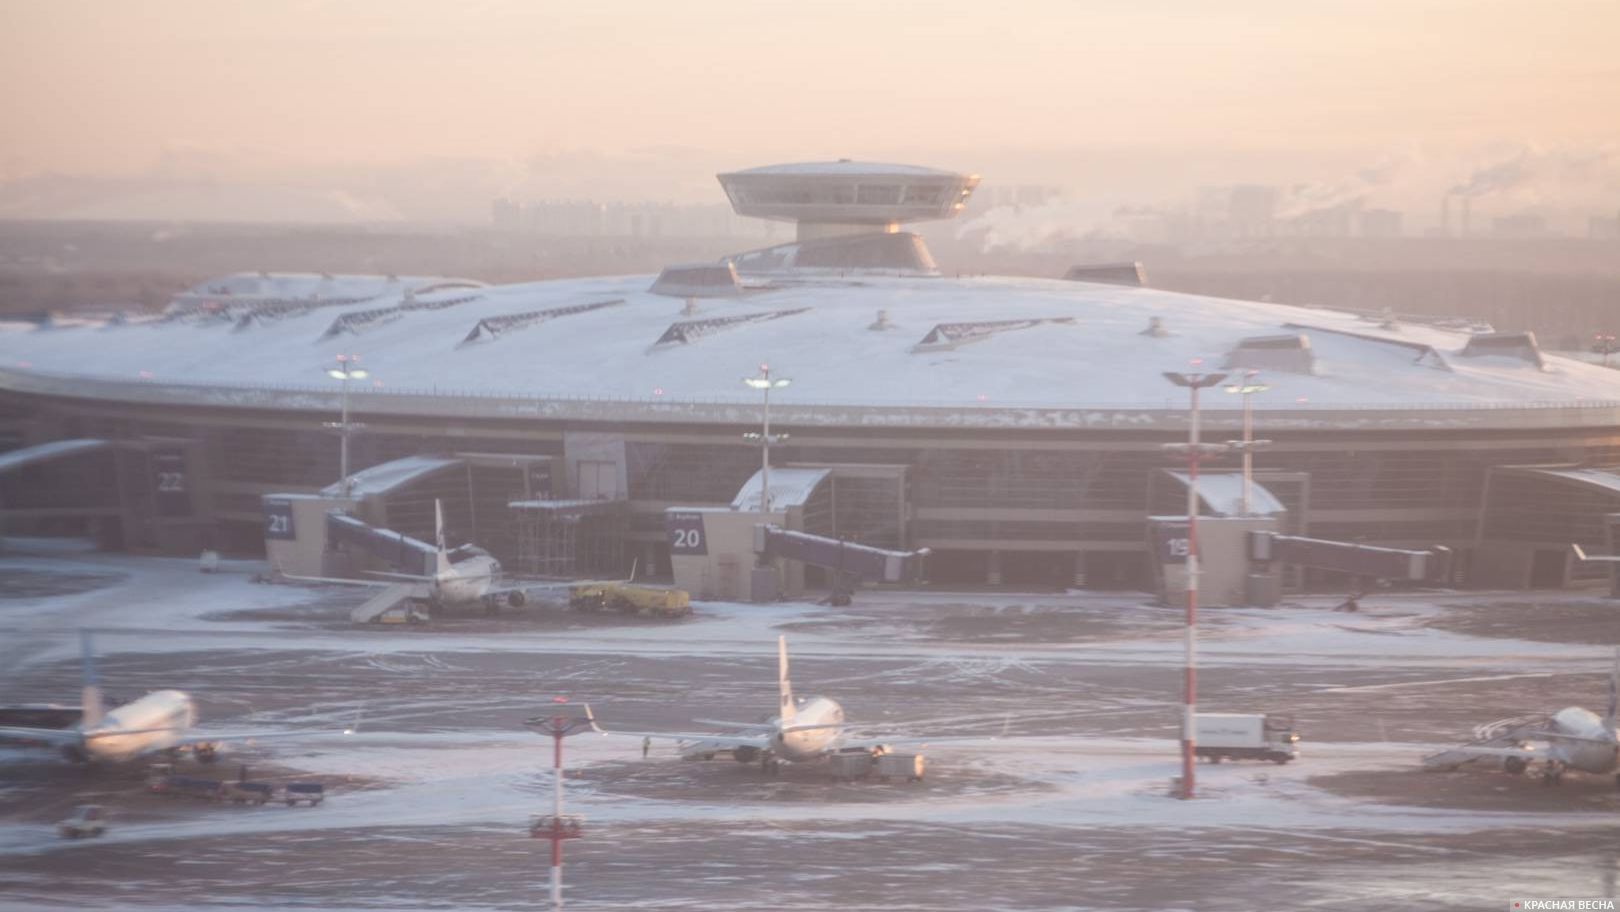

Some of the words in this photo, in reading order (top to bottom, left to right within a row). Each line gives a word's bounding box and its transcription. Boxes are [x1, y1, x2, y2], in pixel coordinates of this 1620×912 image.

[158, 472, 183, 491] 22
[269, 514, 288, 532] 21
[673, 529, 700, 547] 20
